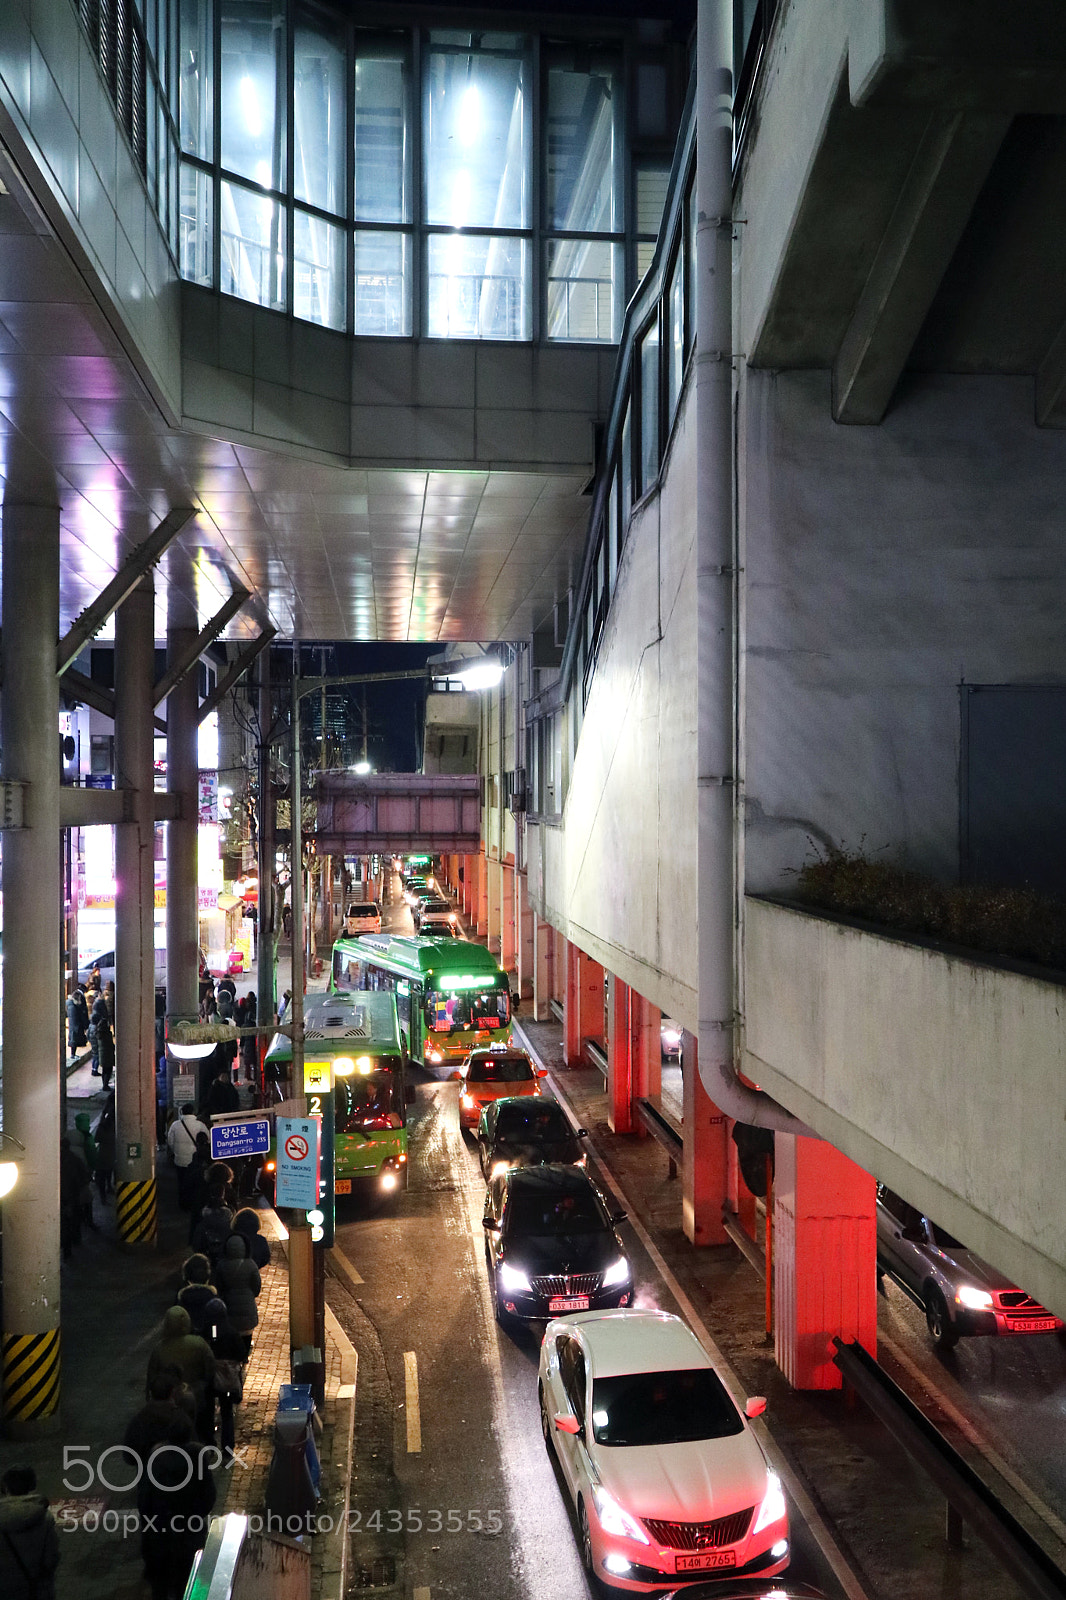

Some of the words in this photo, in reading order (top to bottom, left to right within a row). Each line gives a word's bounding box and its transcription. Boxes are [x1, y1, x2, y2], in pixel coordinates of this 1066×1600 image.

[310, 1096, 321, 1113] 2
[221, 1126, 249, 1139] 당산로
[216, 1138, 254, 1148] Dangsan-ro
[705, 1554, 730, 1567] 2765
